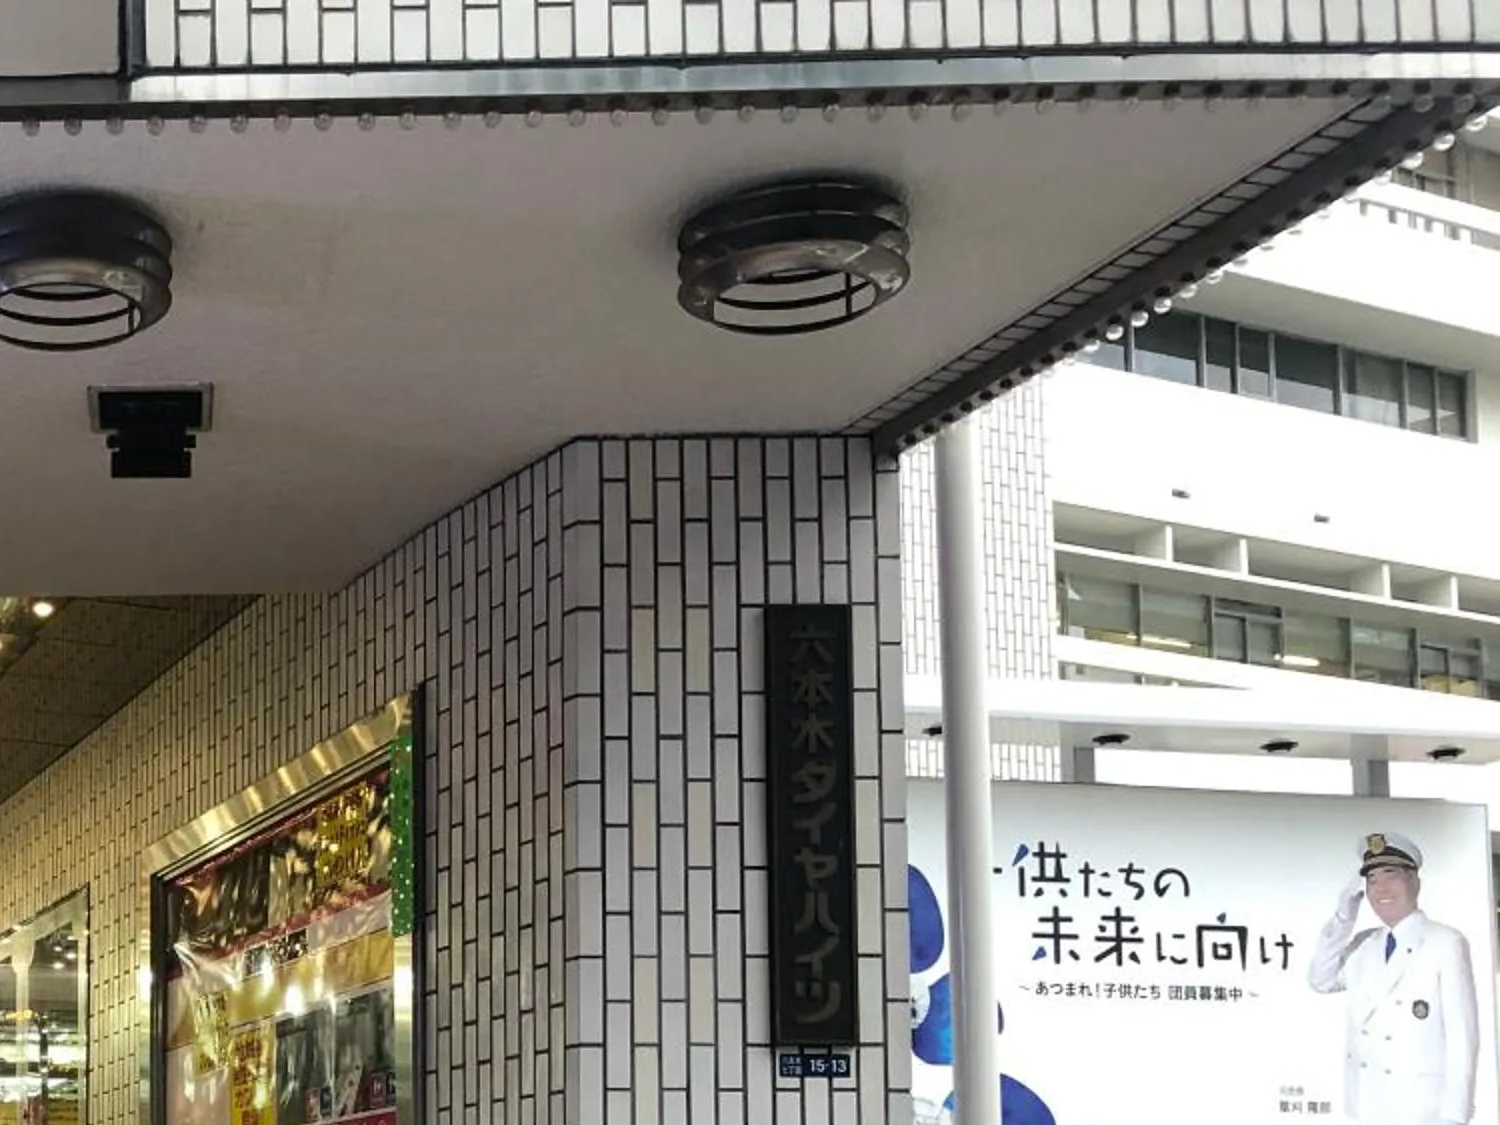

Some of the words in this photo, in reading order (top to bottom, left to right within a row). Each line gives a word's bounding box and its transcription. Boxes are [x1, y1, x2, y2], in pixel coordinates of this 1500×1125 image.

[788, 626, 843, 1025] 六本木ダイヤハイツ
[992, 840, 1190, 901] 供たちの
[1031, 905, 1295, 971] 未来に向け
[1167, 984, 1244, 1002] 団員募集中
[809, 1058, 847, 1074] 15-13
